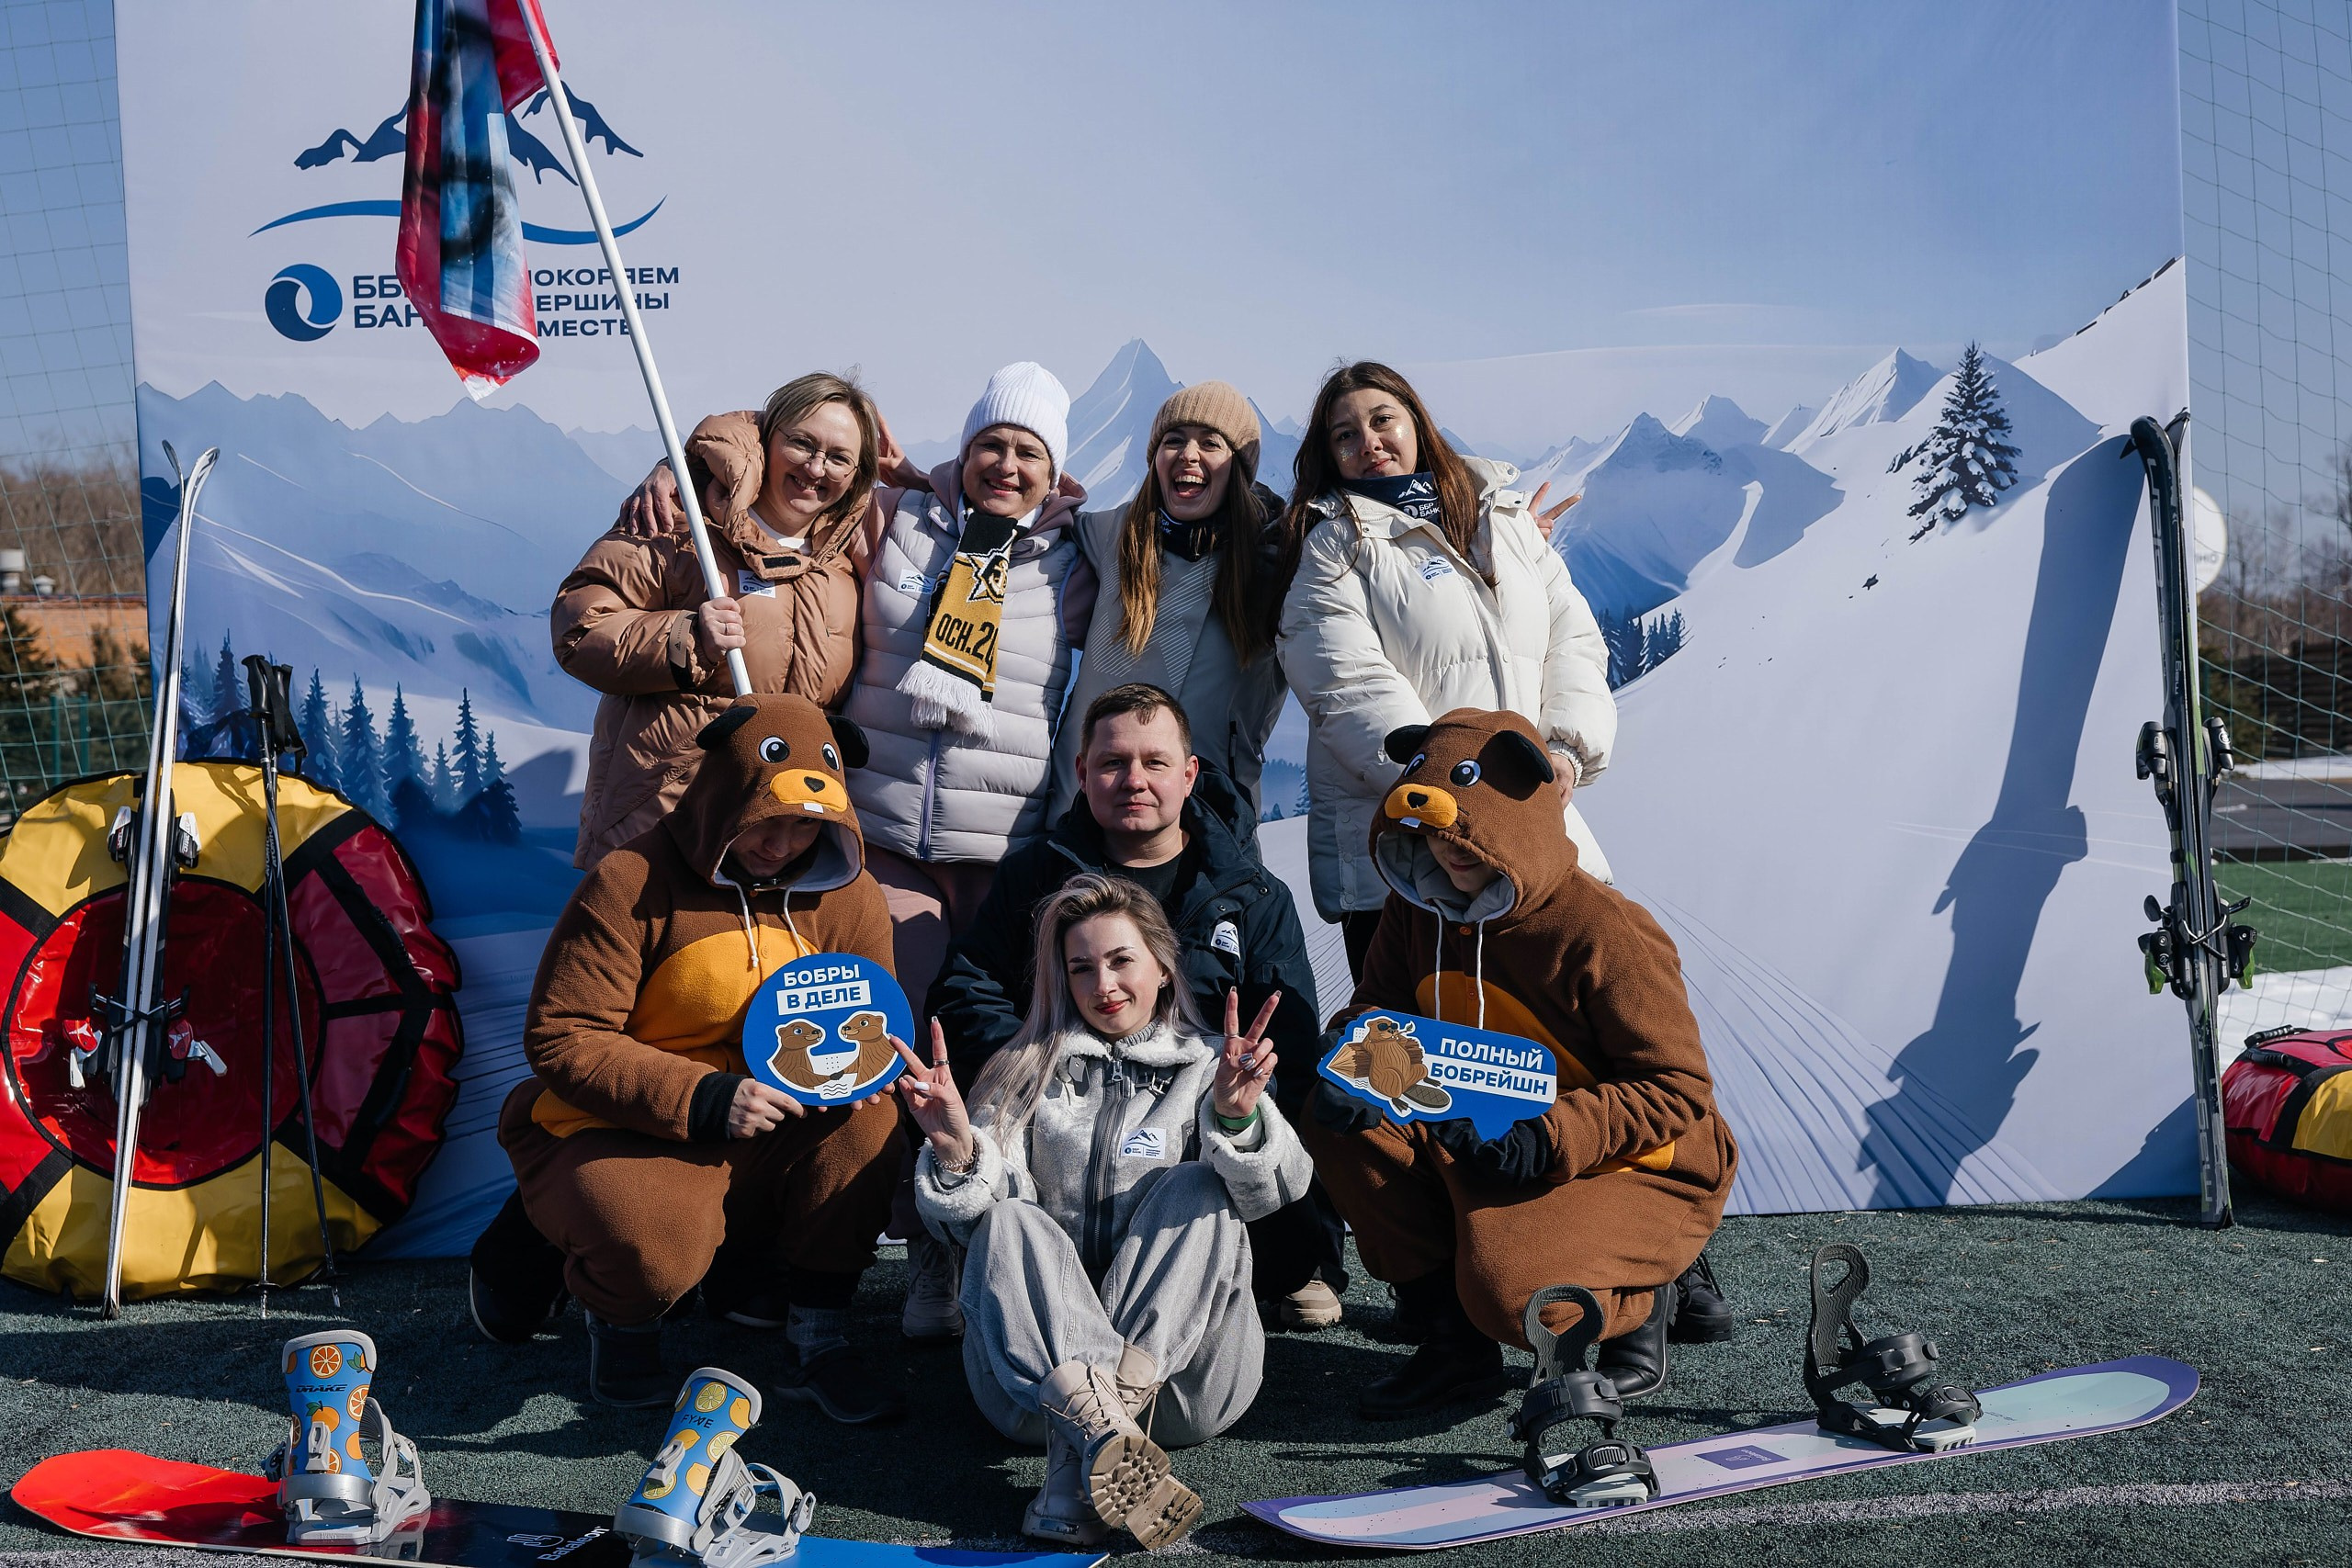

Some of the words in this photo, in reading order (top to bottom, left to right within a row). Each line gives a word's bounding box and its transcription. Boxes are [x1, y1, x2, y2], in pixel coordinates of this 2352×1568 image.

[353, 275, 409, 299] ББ
[528, 267, 679, 286] ОКОРЯЕМ
[536, 292, 669, 311] ЕРШИНЫ
[355, 304, 428, 328] БАН
[537, 319, 630, 337] МЕСТЕ
[1419, 502, 1434, 511] ББР
[1419, 506, 1441, 517] БАНК
[784, 964, 861, 987] БОБРЫ
[786, 994, 800, 1009] В
[805, 987, 862, 1010] ДЕЛЕ
[1440, 1037, 1544, 1071] ПОЛНЫЙ
[1430, 1062, 1549, 1096] БОБРЕЙШН
[296, 1383, 348, 1393] DRAKE
[537, 1527, 611, 1561] Bataleon
